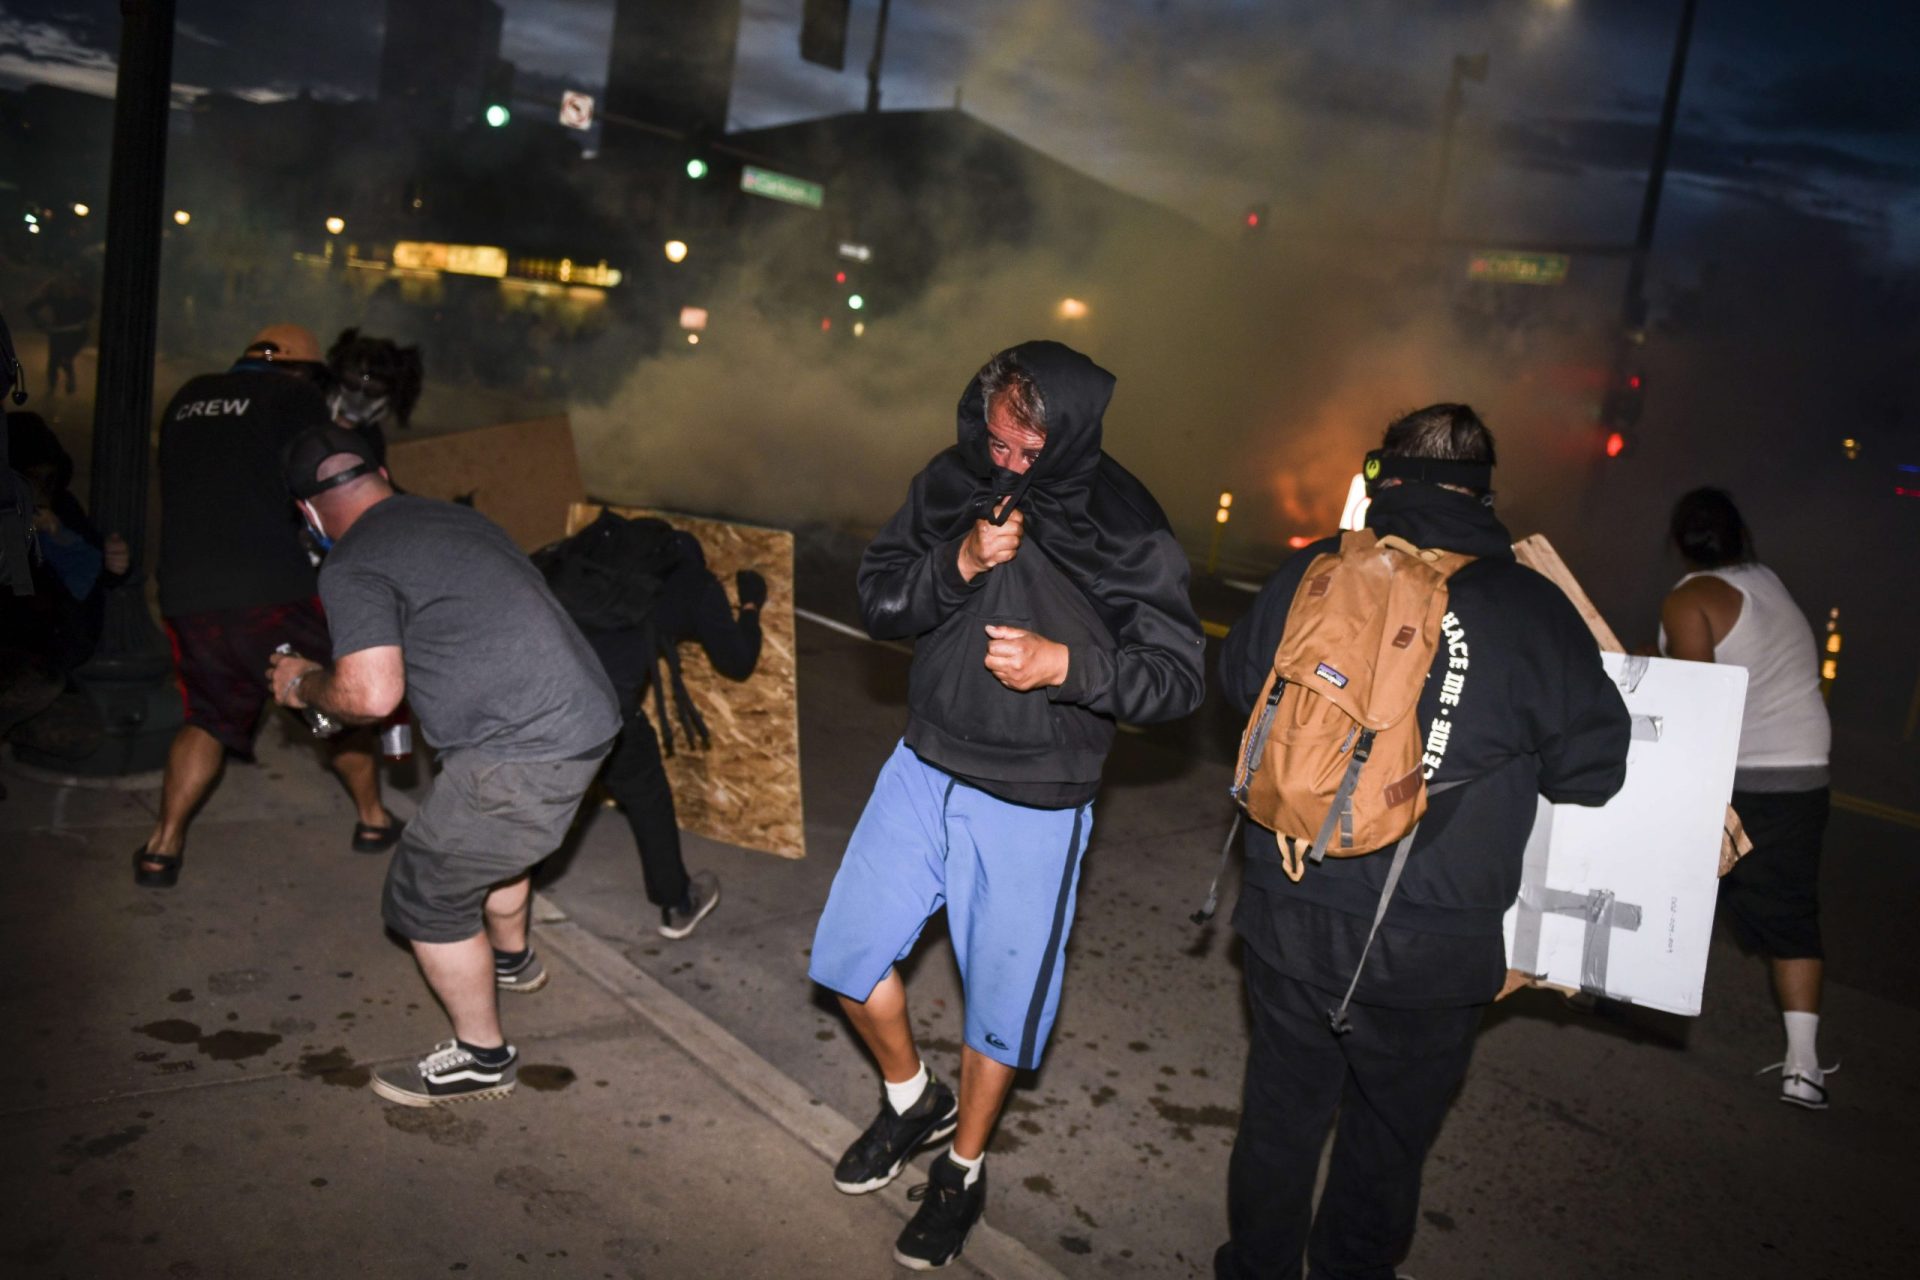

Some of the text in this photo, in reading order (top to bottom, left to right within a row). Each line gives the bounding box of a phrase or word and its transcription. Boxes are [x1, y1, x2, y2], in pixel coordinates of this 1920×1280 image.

[176, 398, 250, 421] CREW
[1439, 670, 1465, 707] ME
[1426, 717, 1452, 756] ME
